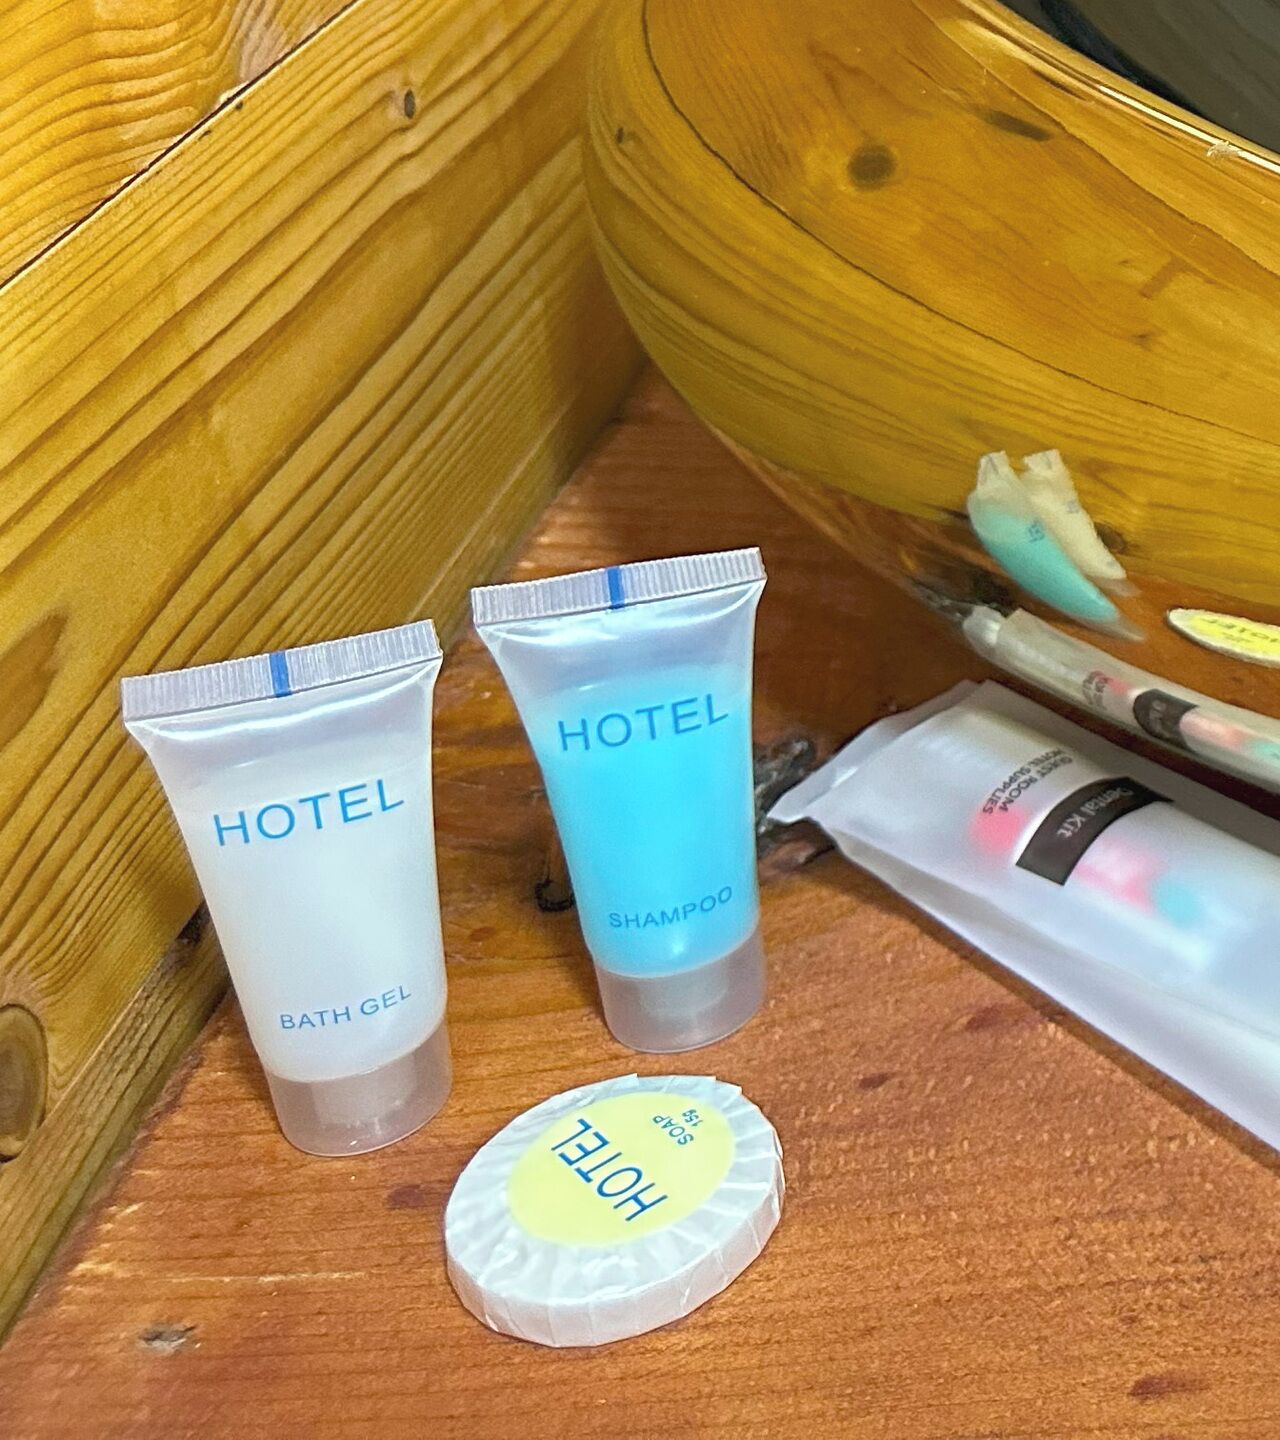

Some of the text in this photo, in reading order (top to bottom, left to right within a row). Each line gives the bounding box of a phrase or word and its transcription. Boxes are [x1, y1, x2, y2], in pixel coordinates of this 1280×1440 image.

[558, 692, 730, 752] HOTEL
[213, 778, 405, 847] HOTEL
[982, 765, 1031, 815] SUPPLIES
[998, 776, 1038, 813] ROOM
[1055, 785, 1135, 839] Dental Kit
[608, 885, 734, 929] SHAMPOO
[280, 984, 413, 1031] BATH GEL
[652, 1115, 694, 1145] SOAP
[550, 1118, 669, 1222] HOTEL
